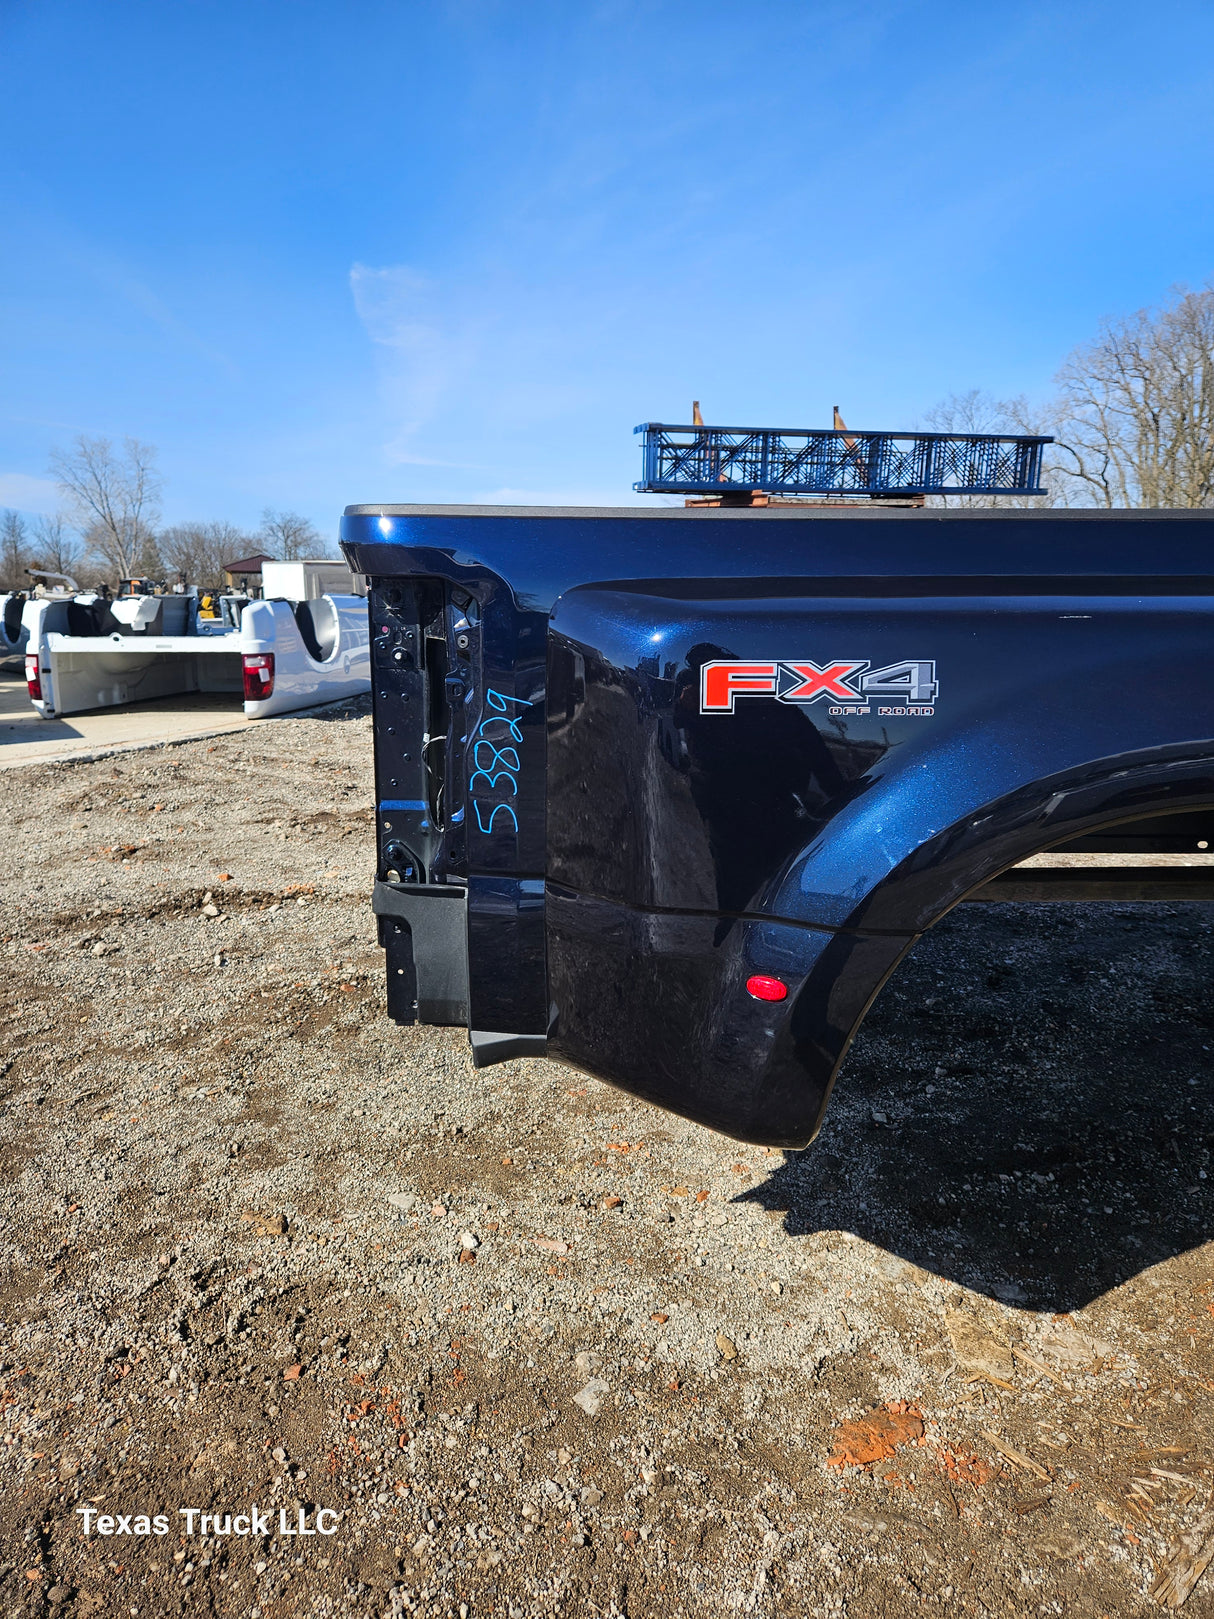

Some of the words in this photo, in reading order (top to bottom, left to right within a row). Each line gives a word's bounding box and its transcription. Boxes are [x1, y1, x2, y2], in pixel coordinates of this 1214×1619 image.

[700, 660, 939, 715] FX4
[828, 706, 871, 716] OFF
[877, 706, 935, 716] ROAD
[469, 688, 534, 834] 53829
